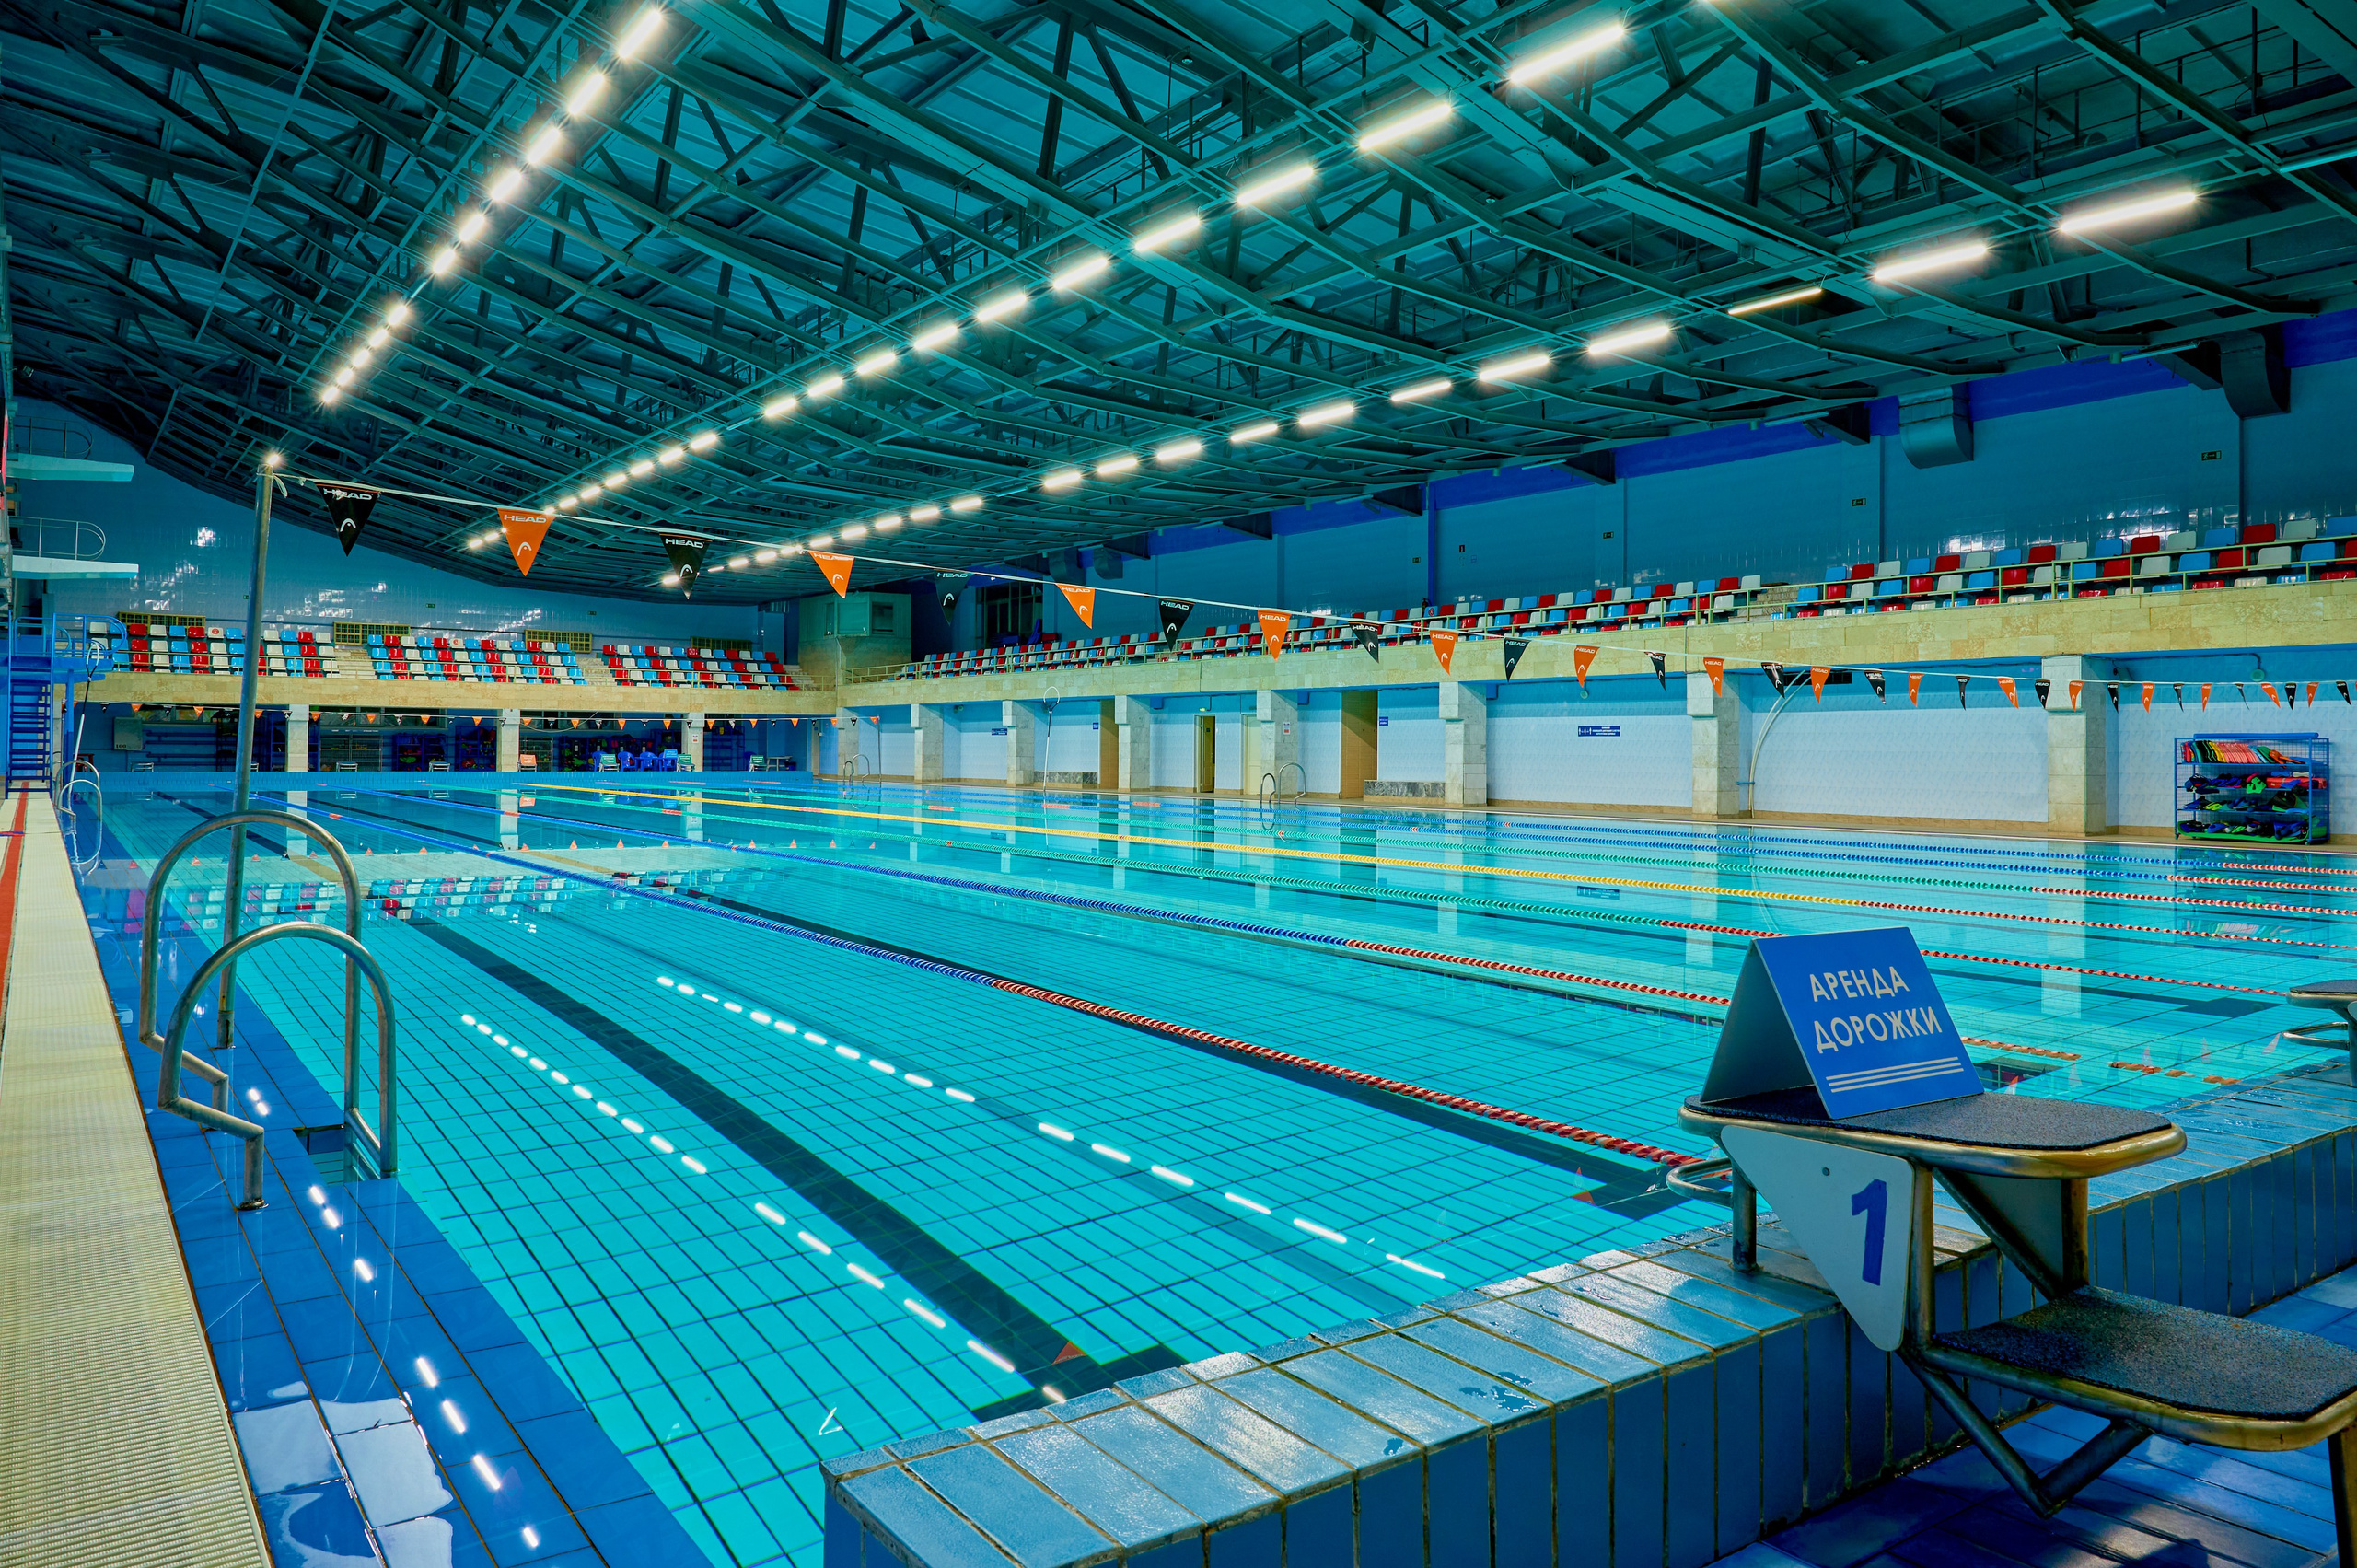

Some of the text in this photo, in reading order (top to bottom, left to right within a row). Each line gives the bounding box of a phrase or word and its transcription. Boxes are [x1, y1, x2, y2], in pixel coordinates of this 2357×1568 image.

[503, 514, 547, 523] HEAD
[665, 538, 704, 549] HEAD
[813, 552, 854, 561] HEA
[1160, 600, 1190, 610] HEAD
[1809, 966, 1910, 1003] АРЕНДА
[1814, 1005, 1943, 1054] ДОРОЖКИ
[1851, 1179, 1888, 1286] 1
